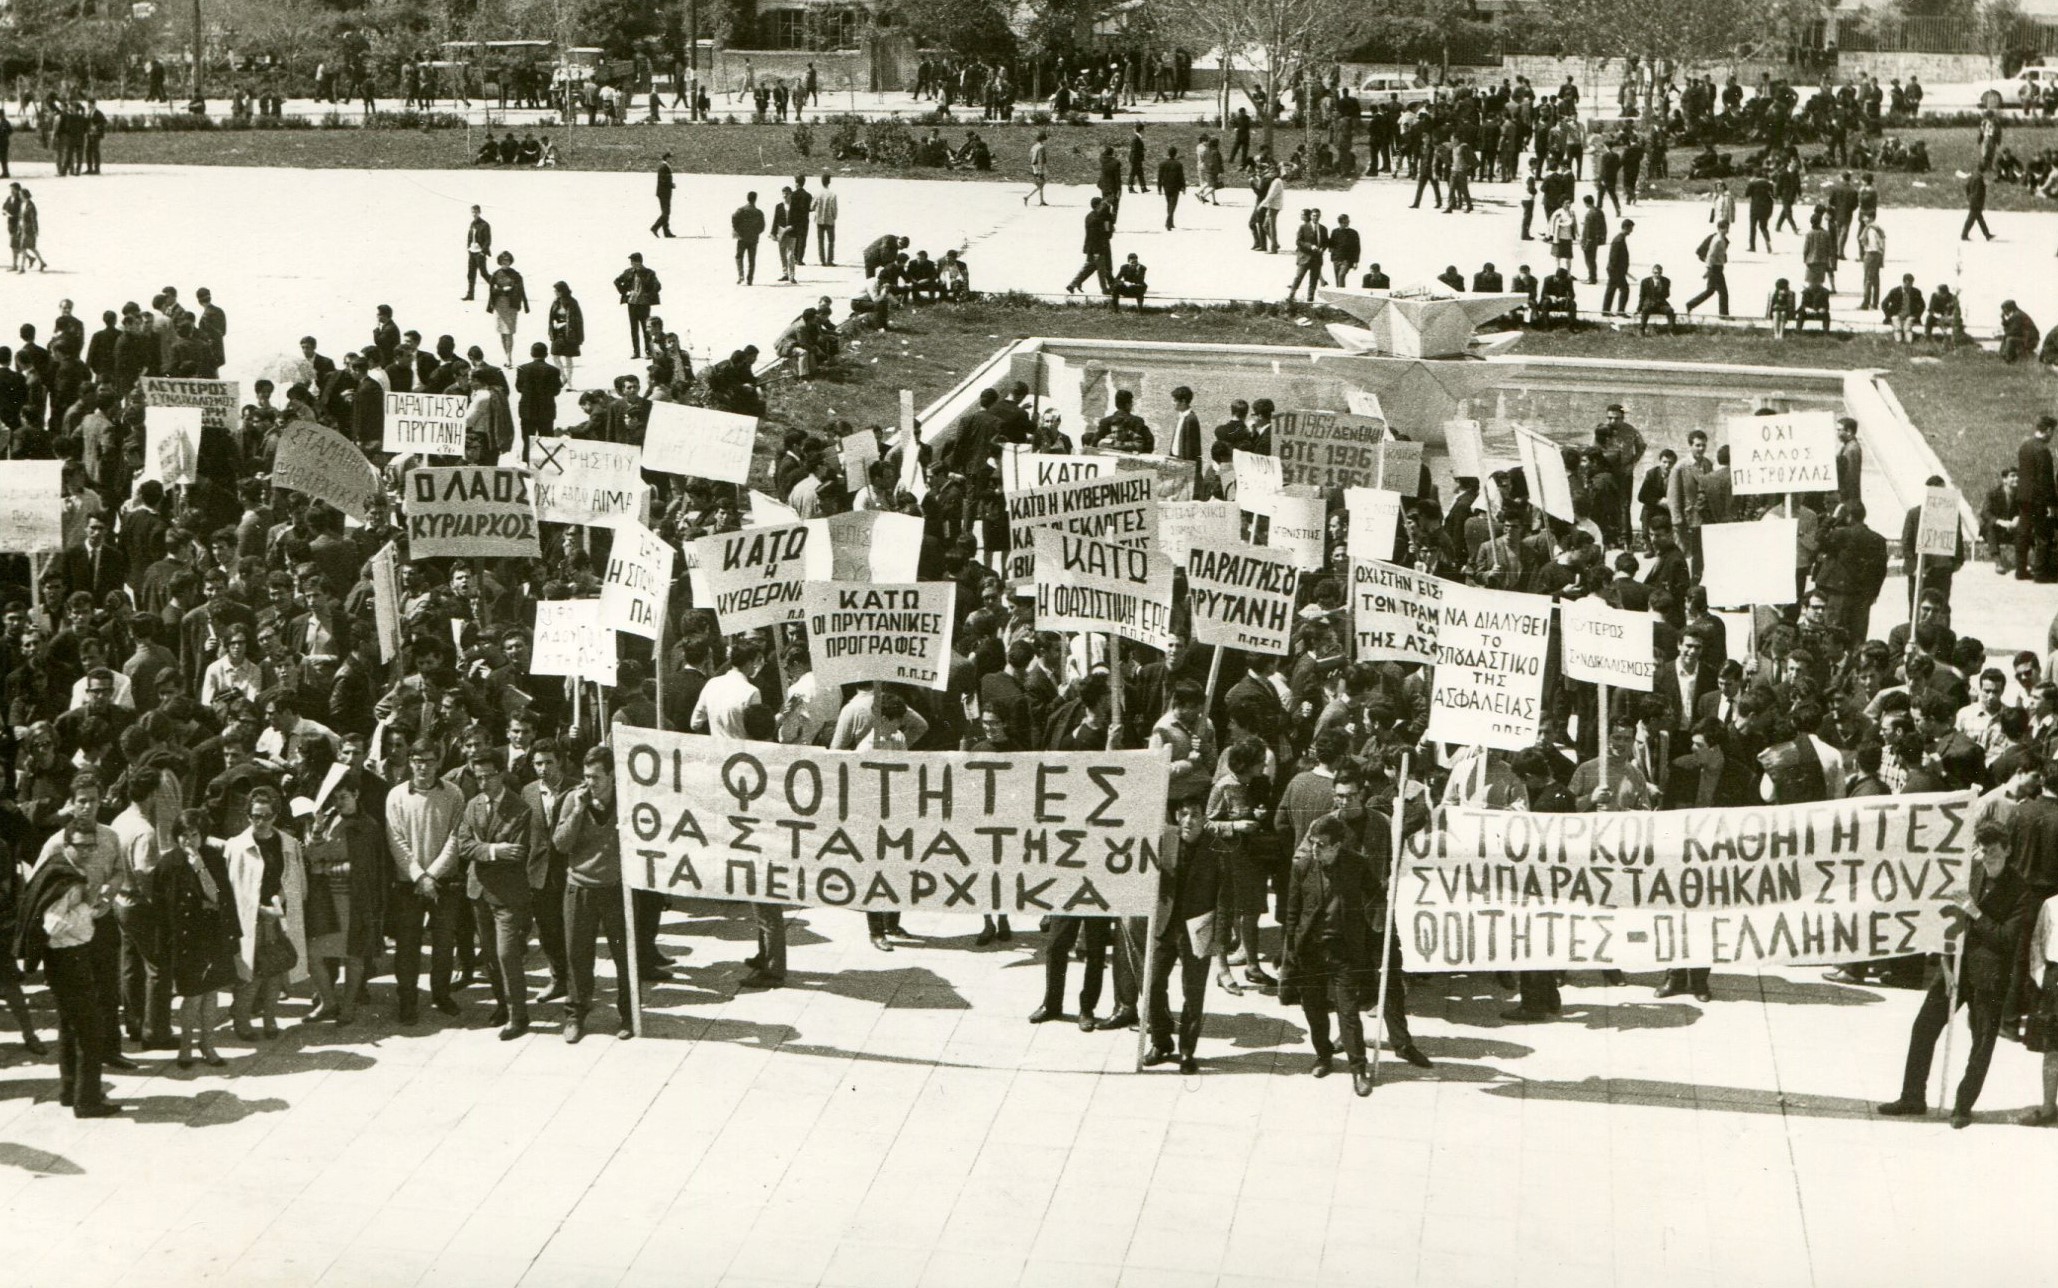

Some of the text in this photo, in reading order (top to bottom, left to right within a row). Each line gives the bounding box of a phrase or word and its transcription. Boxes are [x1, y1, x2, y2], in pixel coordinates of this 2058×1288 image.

[397, 419, 463, 444] ΠΡΥΤΑΝΗ
[1271, 412, 1297, 436] ΤΟ
[1761, 425, 1793, 443] ΟΧΙ
[1326, 444, 1373, 469] 1936
[1751, 447, 1813, 463] ΑΛΛΟΣ
[1038, 461, 1099, 486] ΚΑΤΩ
[414, 470, 534, 506] Ο ΛΑΟΣ
[533, 483, 555, 507] ΟΧΙ
[1010, 478, 1151, 521] ΚΑΤΩ Η ΚΥΒΕΡΝΗΣΗ
[411, 512, 536, 541] ΚΥΡΙΑΡΧΟΣ
[722, 526, 809, 573] ΚΑΤΩ
[1062, 535, 1147, 585] ΚΑΤΩ
[607, 558, 624, 584] Η
[763, 563, 779, 579] Η
[1356, 565, 1378, 585] ΟΧΙ
[1380, 570, 1413, 592] ΣΤΗΝ
[839, 589, 920, 610] ΚΑΤΩ
[1038, 582, 1170, 643] Η ΦΑΣΙΣΤΙΚΗ ΕΡΕ
[1361, 593, 1396, 614] ΤΩΝ
[812, 612, 943, 635] ΟΙ ΠΡΥΤΑΝΙΚΕΣ
[1444, 606, 1548, 637] ΝΑ ΔΙΑΛΥΘΕΙ
[825, 635, 929, 658] ΠΡΟΓΡΑΦΕΣ
[1358, 631, 1396, 649] ΤΗΣ
[1481, 633, 1502, 648] ΤΟ
[1473, 671, 1508, 688] ΤΗΣ
[1434, 687, 1536, 721] ΑΣΦΑΛΕΙΑΣ
[627, 743, 1125, 827] ΟΙ ΦΟΙΤΗΤΕΣ
[631, 801, 709, 847] ΘΑ
[1407, 801, 1970, 866] ΟΙ ΤΟΥΡΚΟΙ ΚΑΘΗΓΗΤΕΣ
[636, 849, 1110, 912] ΤΑ ΠΕΙΘΑΡΧΙΚΑ
[1412, 859, 1964, 909] ΣΥΜΠΑΡΑΣΤΑΘΗΚΑΝ ΣΤΟΥΣ
[1413, 909, 1615, 964] ΦΟΙΤΗΤΕΣ
[1653, 911, 1690, 962] ΟΙ
[1712, 910, 1921, 963] ΕΛΛΗΝΕΣ
